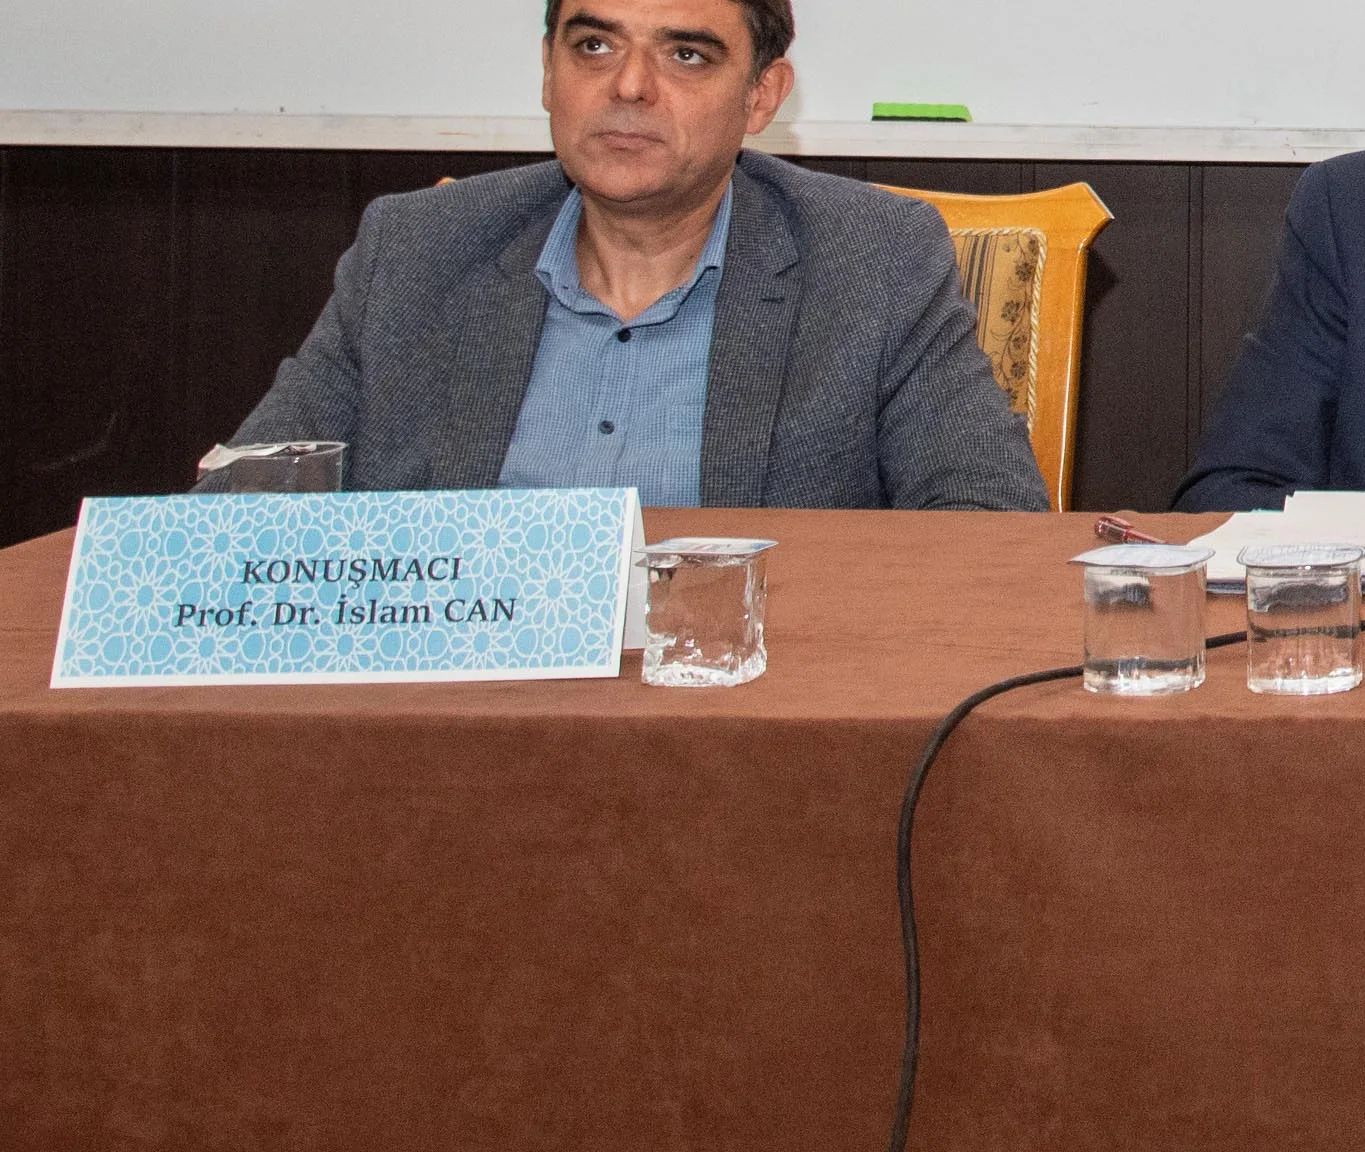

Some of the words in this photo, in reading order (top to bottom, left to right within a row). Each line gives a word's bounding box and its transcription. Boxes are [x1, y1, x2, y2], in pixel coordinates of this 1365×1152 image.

[241, 557, 462, 589] KONUŞMACI
[174, 601, 258, 627] Prof.
[272, 600, 321, 625] Dr.
[334, 593, 431, 625] İslam
[443, 597, 518, 623] CAN
